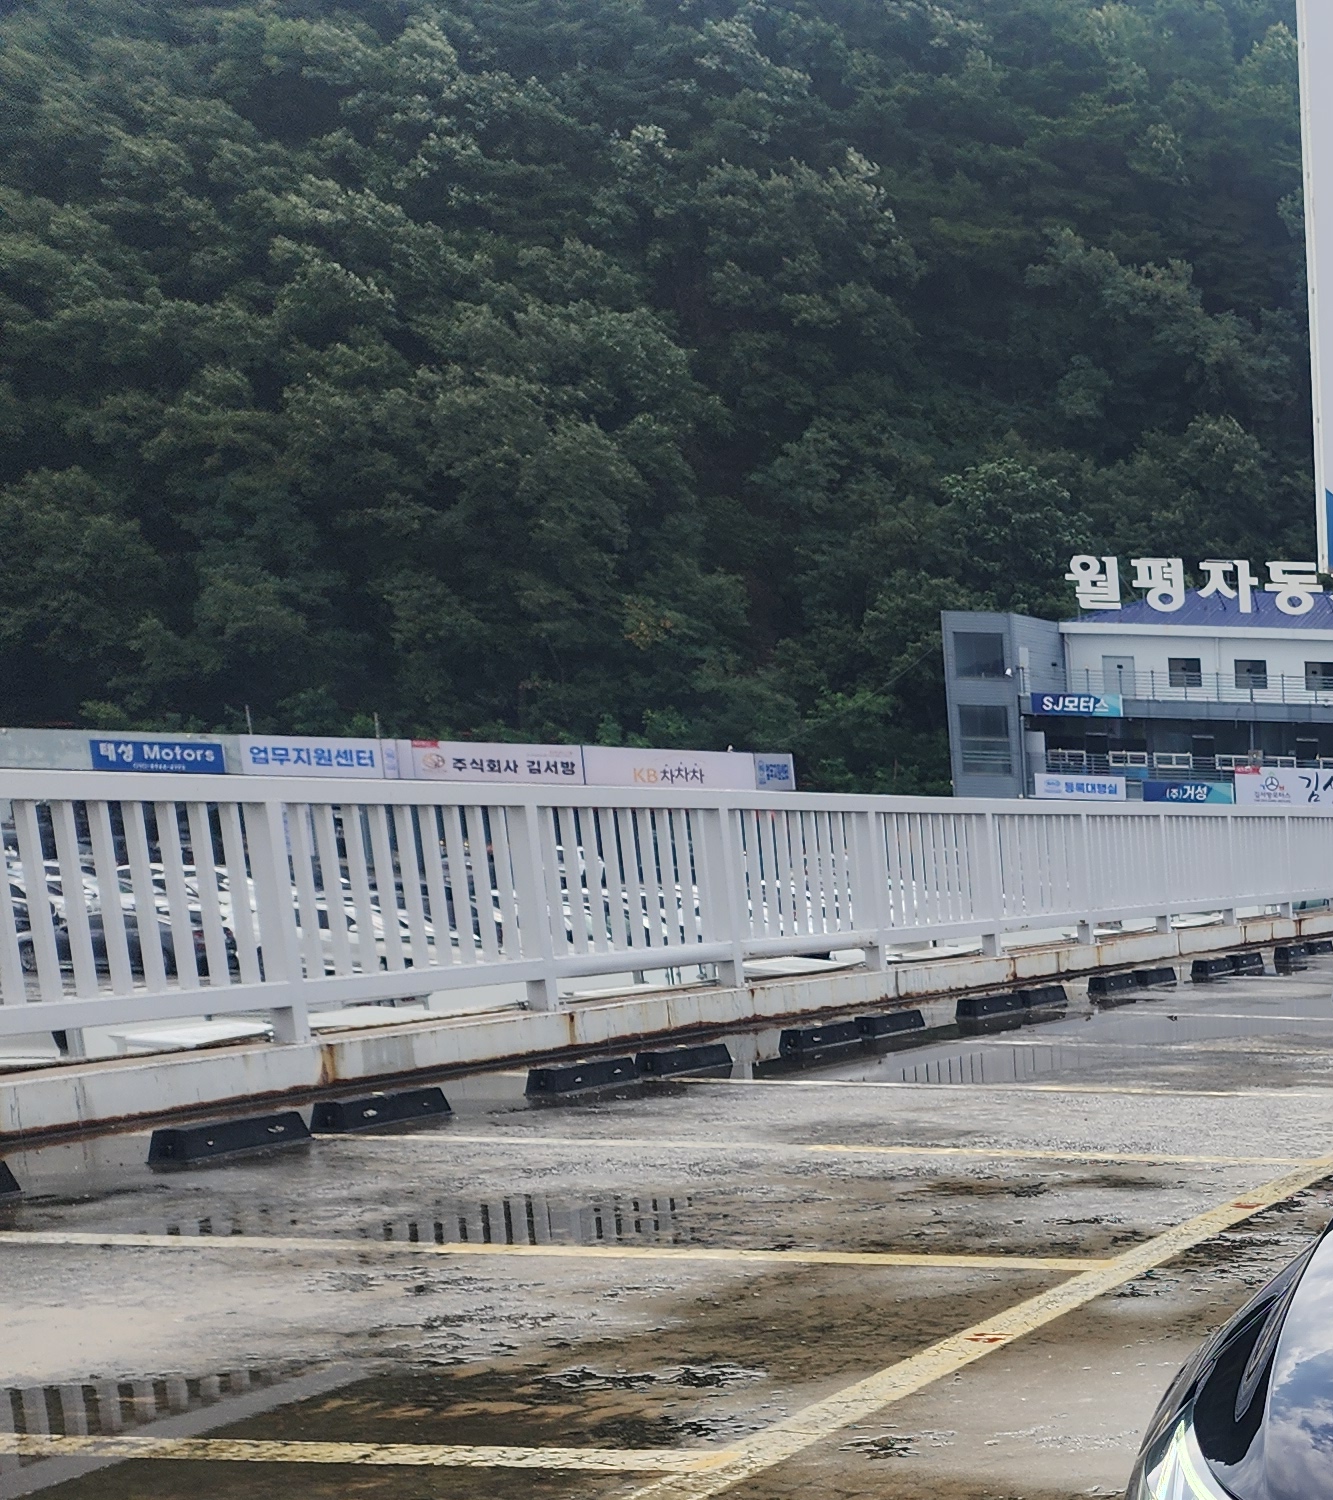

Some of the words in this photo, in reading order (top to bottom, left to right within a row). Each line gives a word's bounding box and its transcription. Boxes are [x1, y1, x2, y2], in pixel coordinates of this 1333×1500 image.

[1042, 696, 1110, 713] SJ모터스
[142, 744, 216, 763] Motors
[250, 745, 377, 768] 업무지원센터
[452, 757, 519, 774] 주식회사
[526, 759, 576, 776] 김서방
